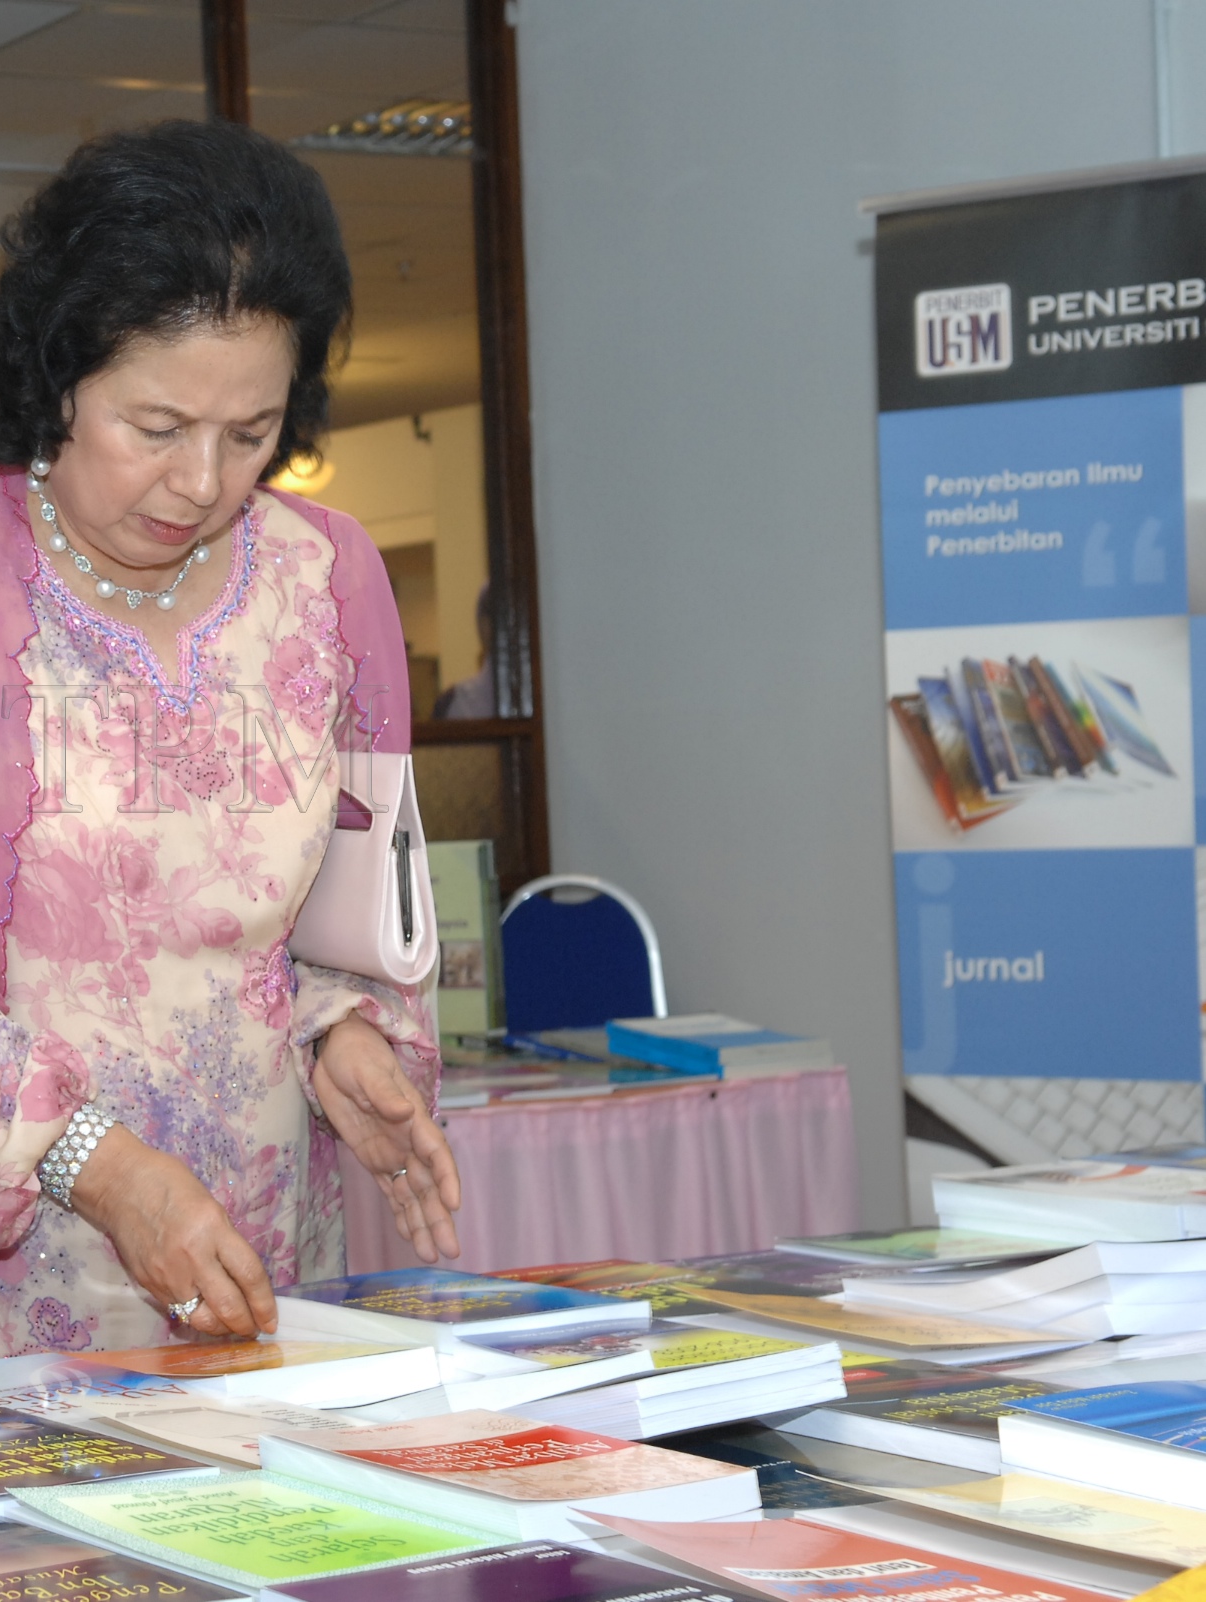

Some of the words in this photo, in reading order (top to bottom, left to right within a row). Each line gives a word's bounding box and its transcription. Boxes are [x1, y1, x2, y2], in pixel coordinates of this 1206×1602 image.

[925, 287, 1003, 313] PENERBIT
[927, 311, 1001, 369] USM
[1027, 316, 1199, 356] UNIVERSITI
[925, 468, 1080, 498] Penyebaran
[1087, 461, 1143, 486] Ilmu
[925, 498, 1018, 527] melalui
[926, 527, 1064, 557] Penerbitan
[942, 949, 1044, 989] jurnal
[29, 1447, 112, 1463] Dasar
[47, 1452, 166, 1470] Perdana
[511, 1439, 612, 1463] Akhbar
[128, 1496, 279, 1526] Al-Quran
[139, 1503, 339, 1540] Pendidikan
[206, 1518, 341, 1546] Kaedah
[270, 1533, 330, 1550] dan
[267, 1534, 407, 1565] Sejarah
[823, 1567, 865, 1578] dan
[863, 1561, 928, 1575] Teori
[57, 1574, 123, 1591] Ibn
